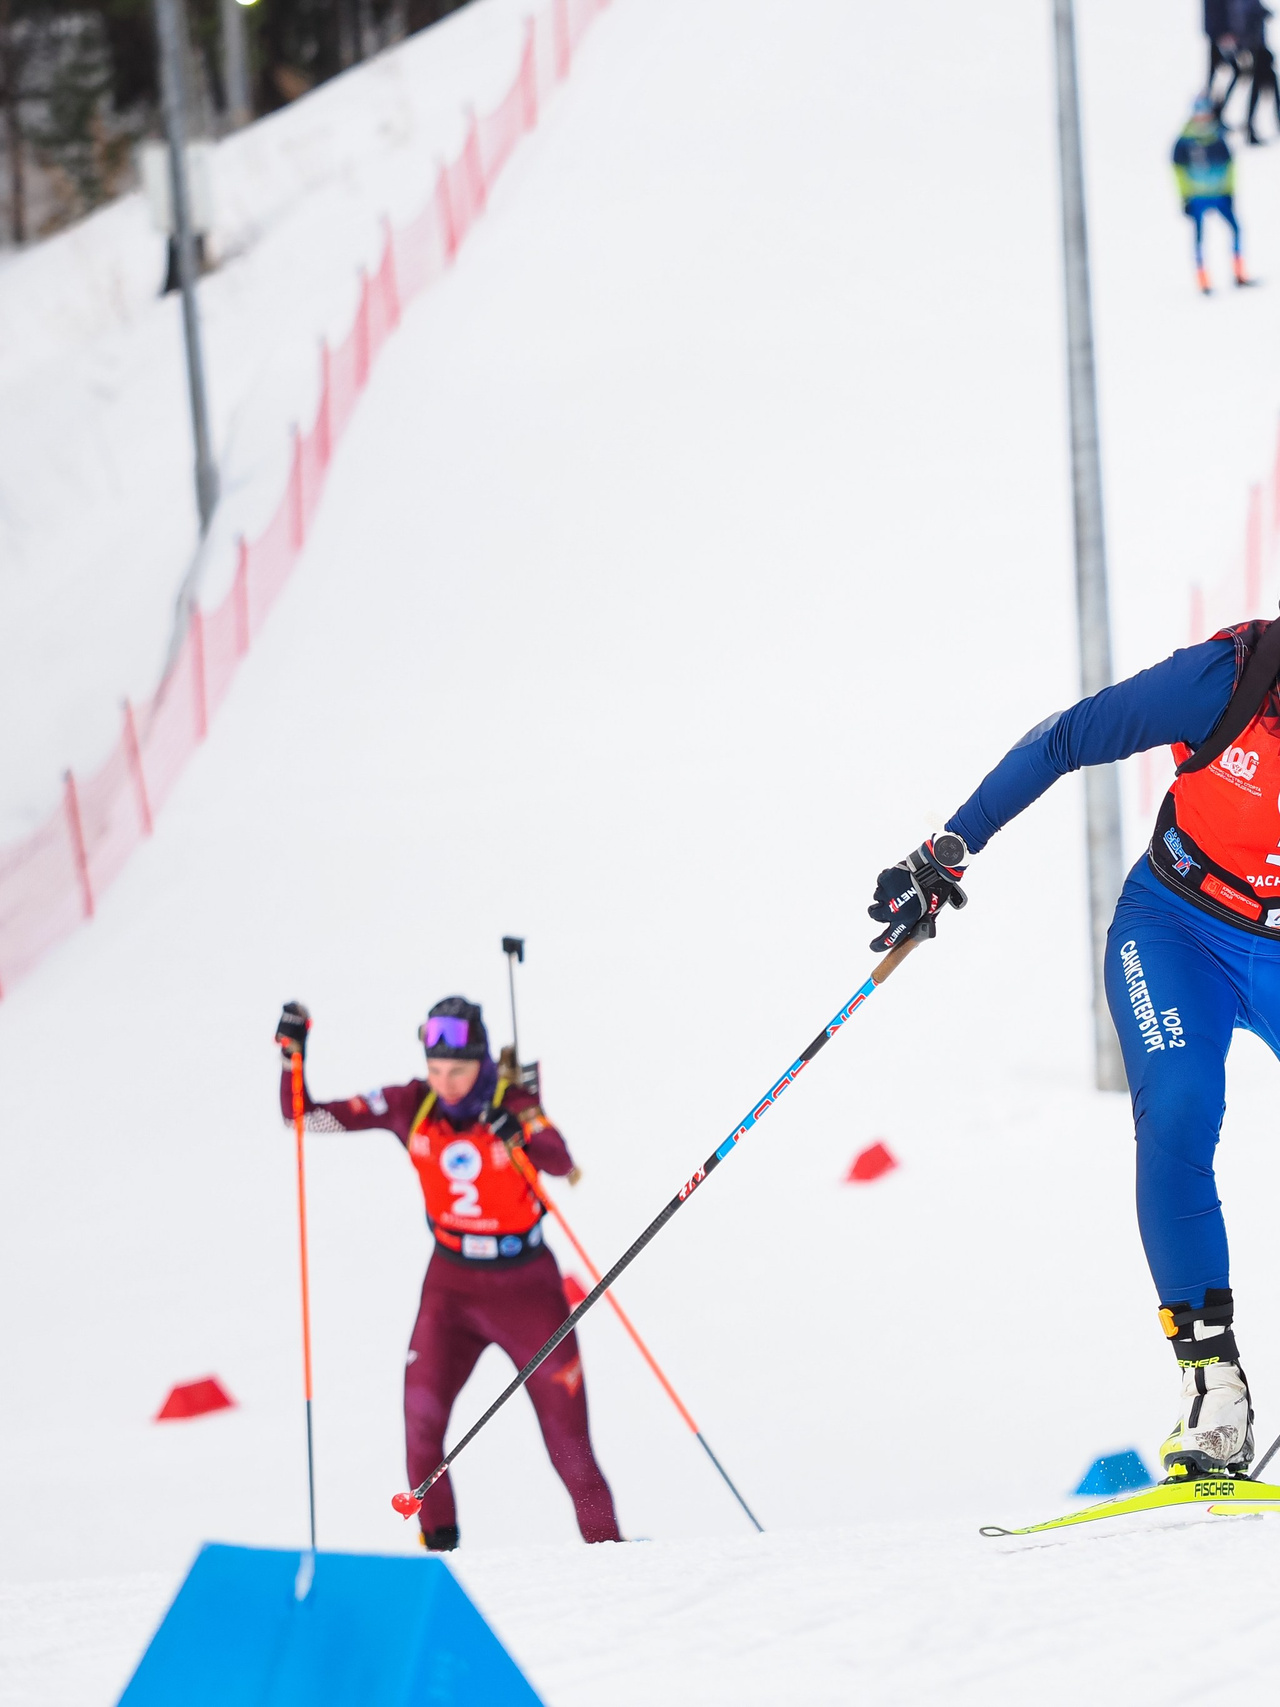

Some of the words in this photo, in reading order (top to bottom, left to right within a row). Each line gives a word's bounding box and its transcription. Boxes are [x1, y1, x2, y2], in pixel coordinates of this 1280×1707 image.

[1120, 940, 1165, 1053] САНКТ-ПЕТЕРБУРГ
[1160, 1007, 1186, 1048] УОР-2
[449, 1181, 482, 1217] 2
[1177, 1356, 1220, 1369] SCHER
[1194, 1482, 1235, 1498] FISCHER
